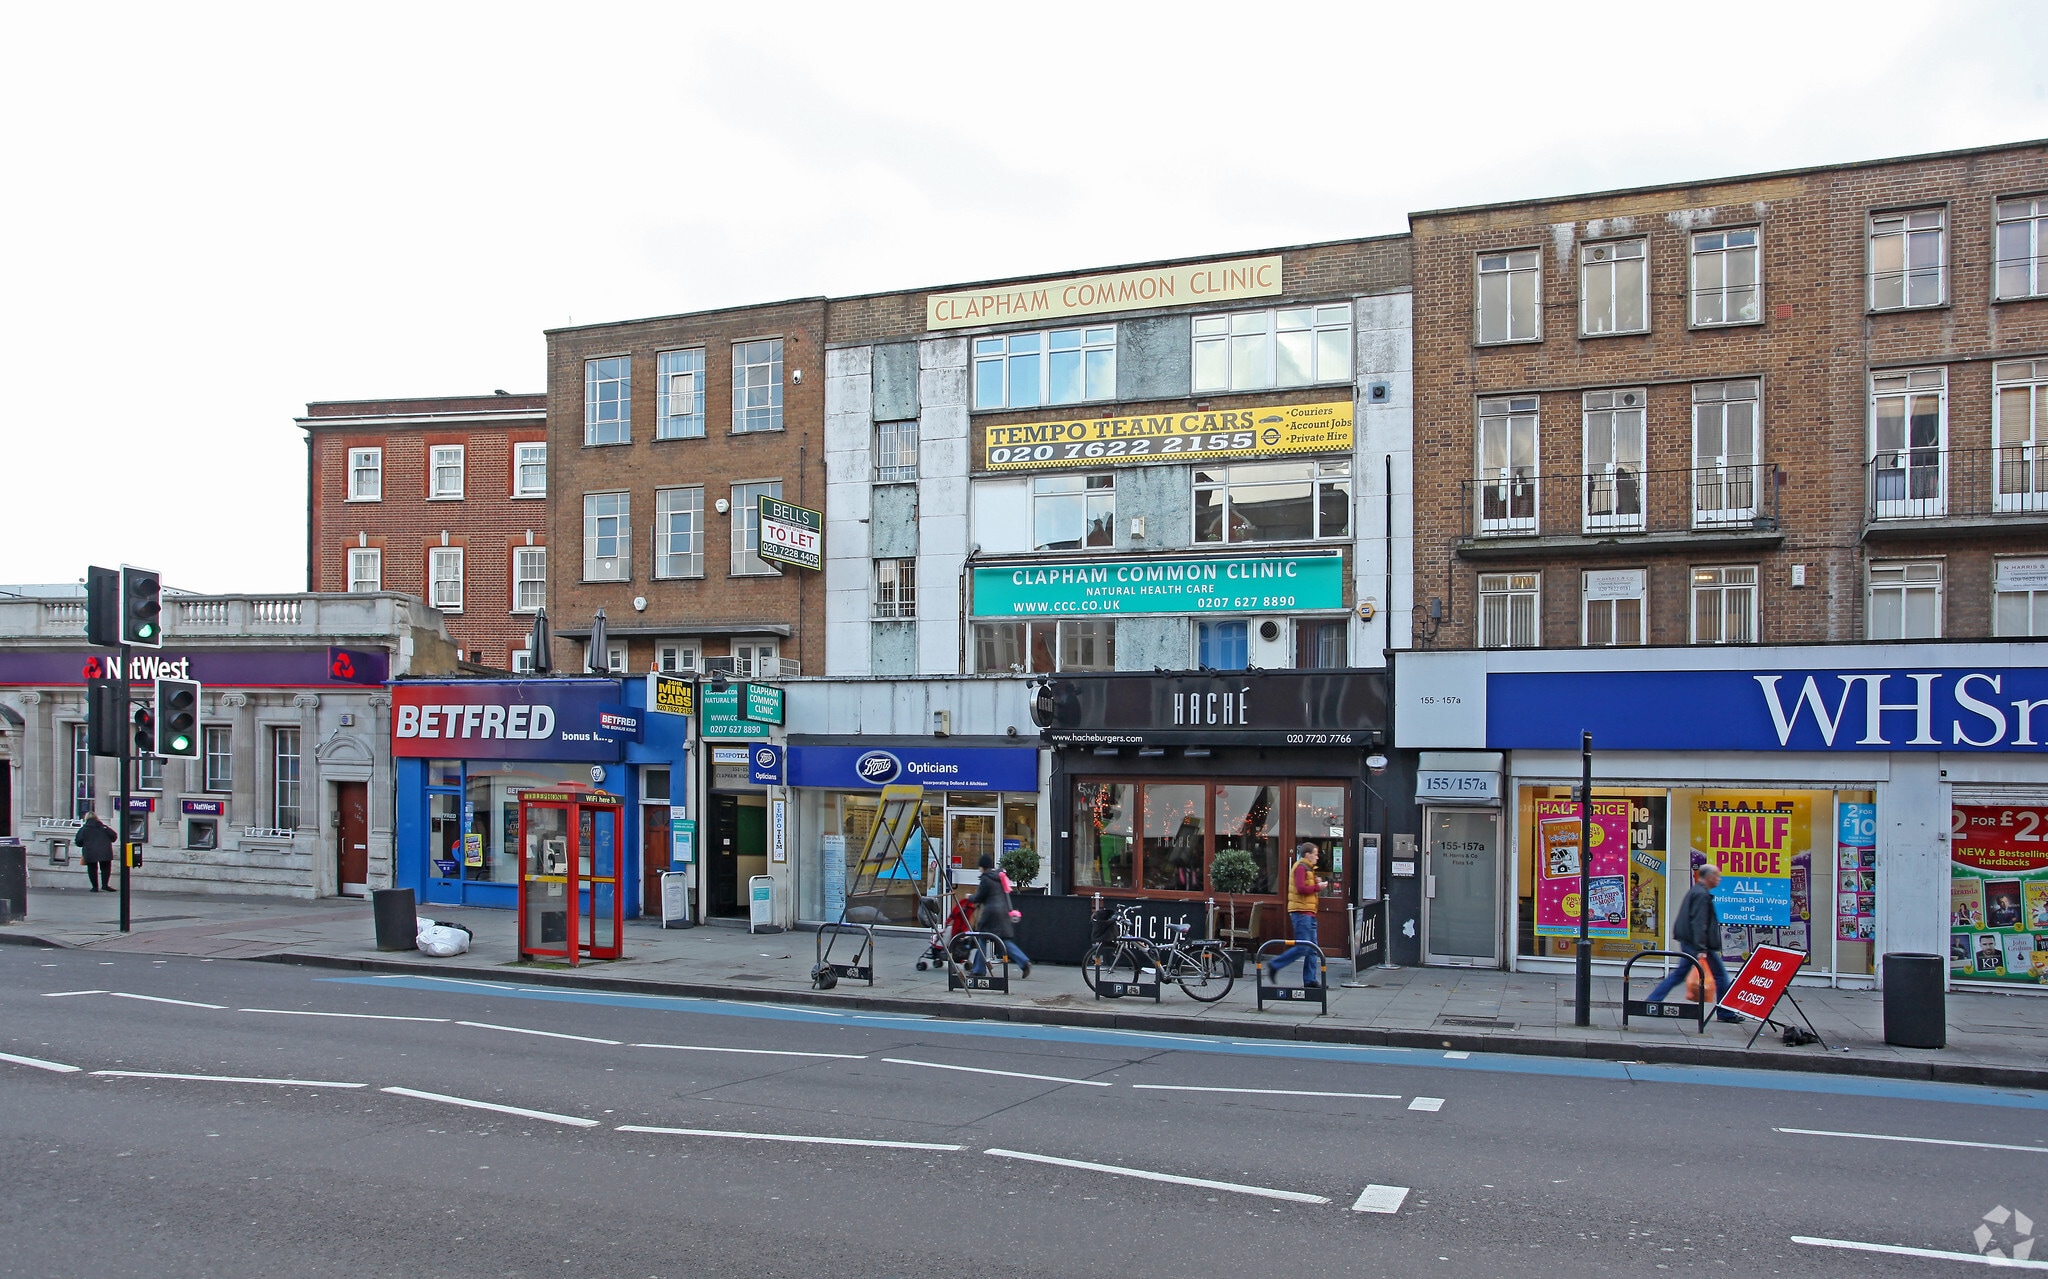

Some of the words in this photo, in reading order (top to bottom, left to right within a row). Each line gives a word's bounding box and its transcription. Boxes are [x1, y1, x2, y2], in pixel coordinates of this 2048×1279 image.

[935, 290, 1050, 322] CLAPHAM
[1063, 275, 1175, 308] COMMON
[1189, 264, 1273, 294] CLINIC
[1291, 407, 1333, 417] Couriers
[990, 422, 1087, 446] TEMPO
[1093, 416, 1173, 439] TEAM
[1180, 411, 1254, 432] CARS
[1290, 420, 1329, 430] Account
[1330, 418, 1352, 430] Jobs
[1290, 434, 1324, 443] Private
[1327, 432, 1348, 441] Hire
[990, 446, 1053, 465] 020
[1064, 441, 1150, 460] 7622
[1161, 432, 1253, 453] 2155
[773, 503, 810, 525] BELLS
[768, 525, 787, 541] TO
[790, 531, 815, 548] LET
[763, 542, 778, 553] 020
[780, 546, 799, 558] 7228
[800, 551, 819, 563] 4405
[1012, 567, 1108, 586] CLAPHAM
[1117, 564, 1218, 583] COMMON
[1226, 561, 1298, 579] CLINIC
[1086, 586, 1136, 597] NATURAL
[1140, 585, 1182, 595] HEALTH
[1186, 584, 1215, 593] CARE
[1013, 600, 1121, 612] WWW.CCC.CO.UK
[1198, 597, 1230, 608] 0207
[1234, 597, 1259, 608] 627
[1263, 596, 1296, 607] 8890
[106, 656, 190, 680] NtWest
[658, 683, 691, 697] MINI
[750, 685, 779, 698] CLAPHAM
[657, 693, 692, 707] CABS
[749, 694, 779, 707] COMMON
[1173, 686, 1250, 725] HACHÉ
[656, 704, 667, 712] 020
[667, 705, 680, 714] 7622
[680, 707, 693, 716] 2155
[754, 705, 774, 715] CLINIC
[396, 704, 556, 741] BETFRED
[602, 714, 637, 727] BETFRED
[562, 731, 590, 741] bonus
[710, 726, 727, 734] 0207
[728, 726, 741, 734] 627
[743, 726, 761, 734] 8890
[1052, 733, 1143, 744] www.hacheburgers.com
[1286, 734, 1302, 744] 020
[1303, 734, 1327, 744] 7720
[1328, 734, 1352, 744] 7766
[862, 758, 892, 776] Boots
[907, 761, 958, 774] Opticians
[755, 771, 777, 781] Opticians
[1426, 778, 1487, 790] 155/157a
[599, 795, 610, 804] here
[193, 802, 216, 811] NatWest
[1540, 803, 1578, 815] HALF
[1592, 804, 1626, 816] RICE
[1847, 805, 1858, 818] 2
[775, 803, 783, 829] TEMPO
[1843, 819, 1876, 835] £10
[1951, 810, 1967, 840] 2
[1971, 816, 1996, 826] FOR
[2000, 810, 2048, 841] £2
[1709, 815, 1789, 850] HALF
[775, 829, 783, 850] TEAM
[1441, 842, 1485, 851] 155-157a
[1958, 847, 1986, 857] NEW
[1989, 849, 1996, 857] &
[1636, 853, 1661, 870] NEW!
[1716, 851, 1781, 874] PRICE
[1979, 858, 2030, 867] Hardbacks
[1733, 881, 1763, 893] ALL
[1714, 895, 1747, 904] hristmas
[1748, 896, 1764, 904] Roll
[1766, 897, 1788, 906] Wrap
[1723, 912, 1748, 921] Boxed
[1749, 913, 1773, 922] Cards
[1760, 959, 1782, 972] ROAD
[1982, 957, 1999, 968] KP
[966, 978, 974, 986] P
[1115, 984, 1122, 993] P
[1748, 975, 1774, 989] AHEAD
[1737, 990, 1765, 1006] CLOSED
[1649, 1004, 1657, 1014] P
